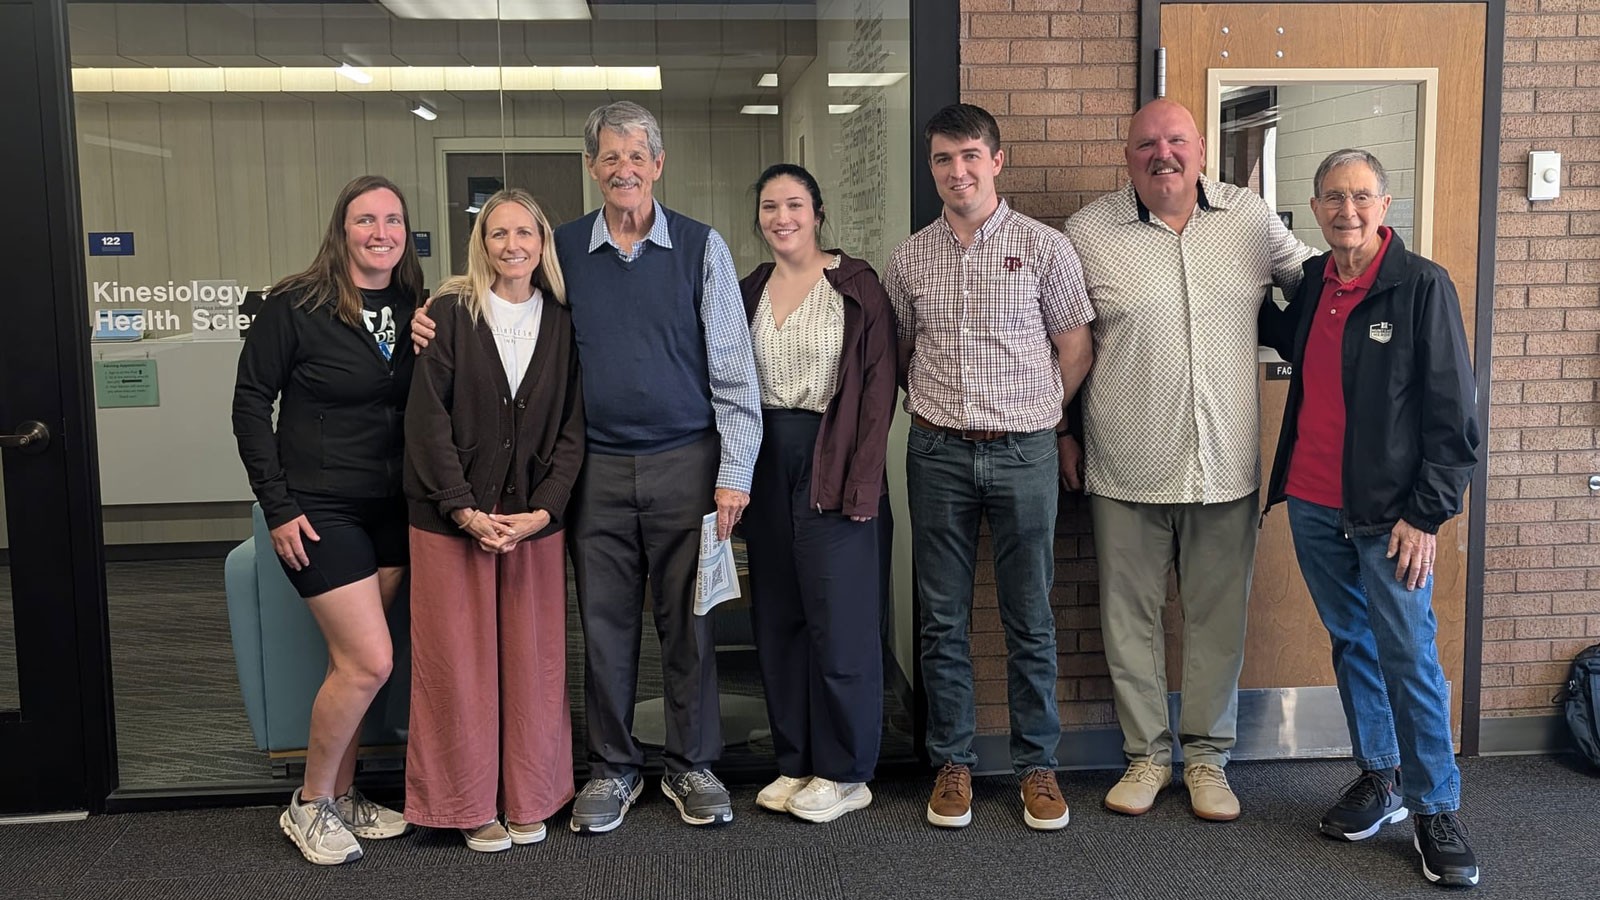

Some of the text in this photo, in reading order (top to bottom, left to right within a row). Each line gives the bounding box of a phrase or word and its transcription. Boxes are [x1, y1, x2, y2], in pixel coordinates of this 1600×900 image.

[101, 236, 121, 246] 122
[93, 281, 249, 306] Kinesiology
[95, 308, 257, 331] Health Scie
